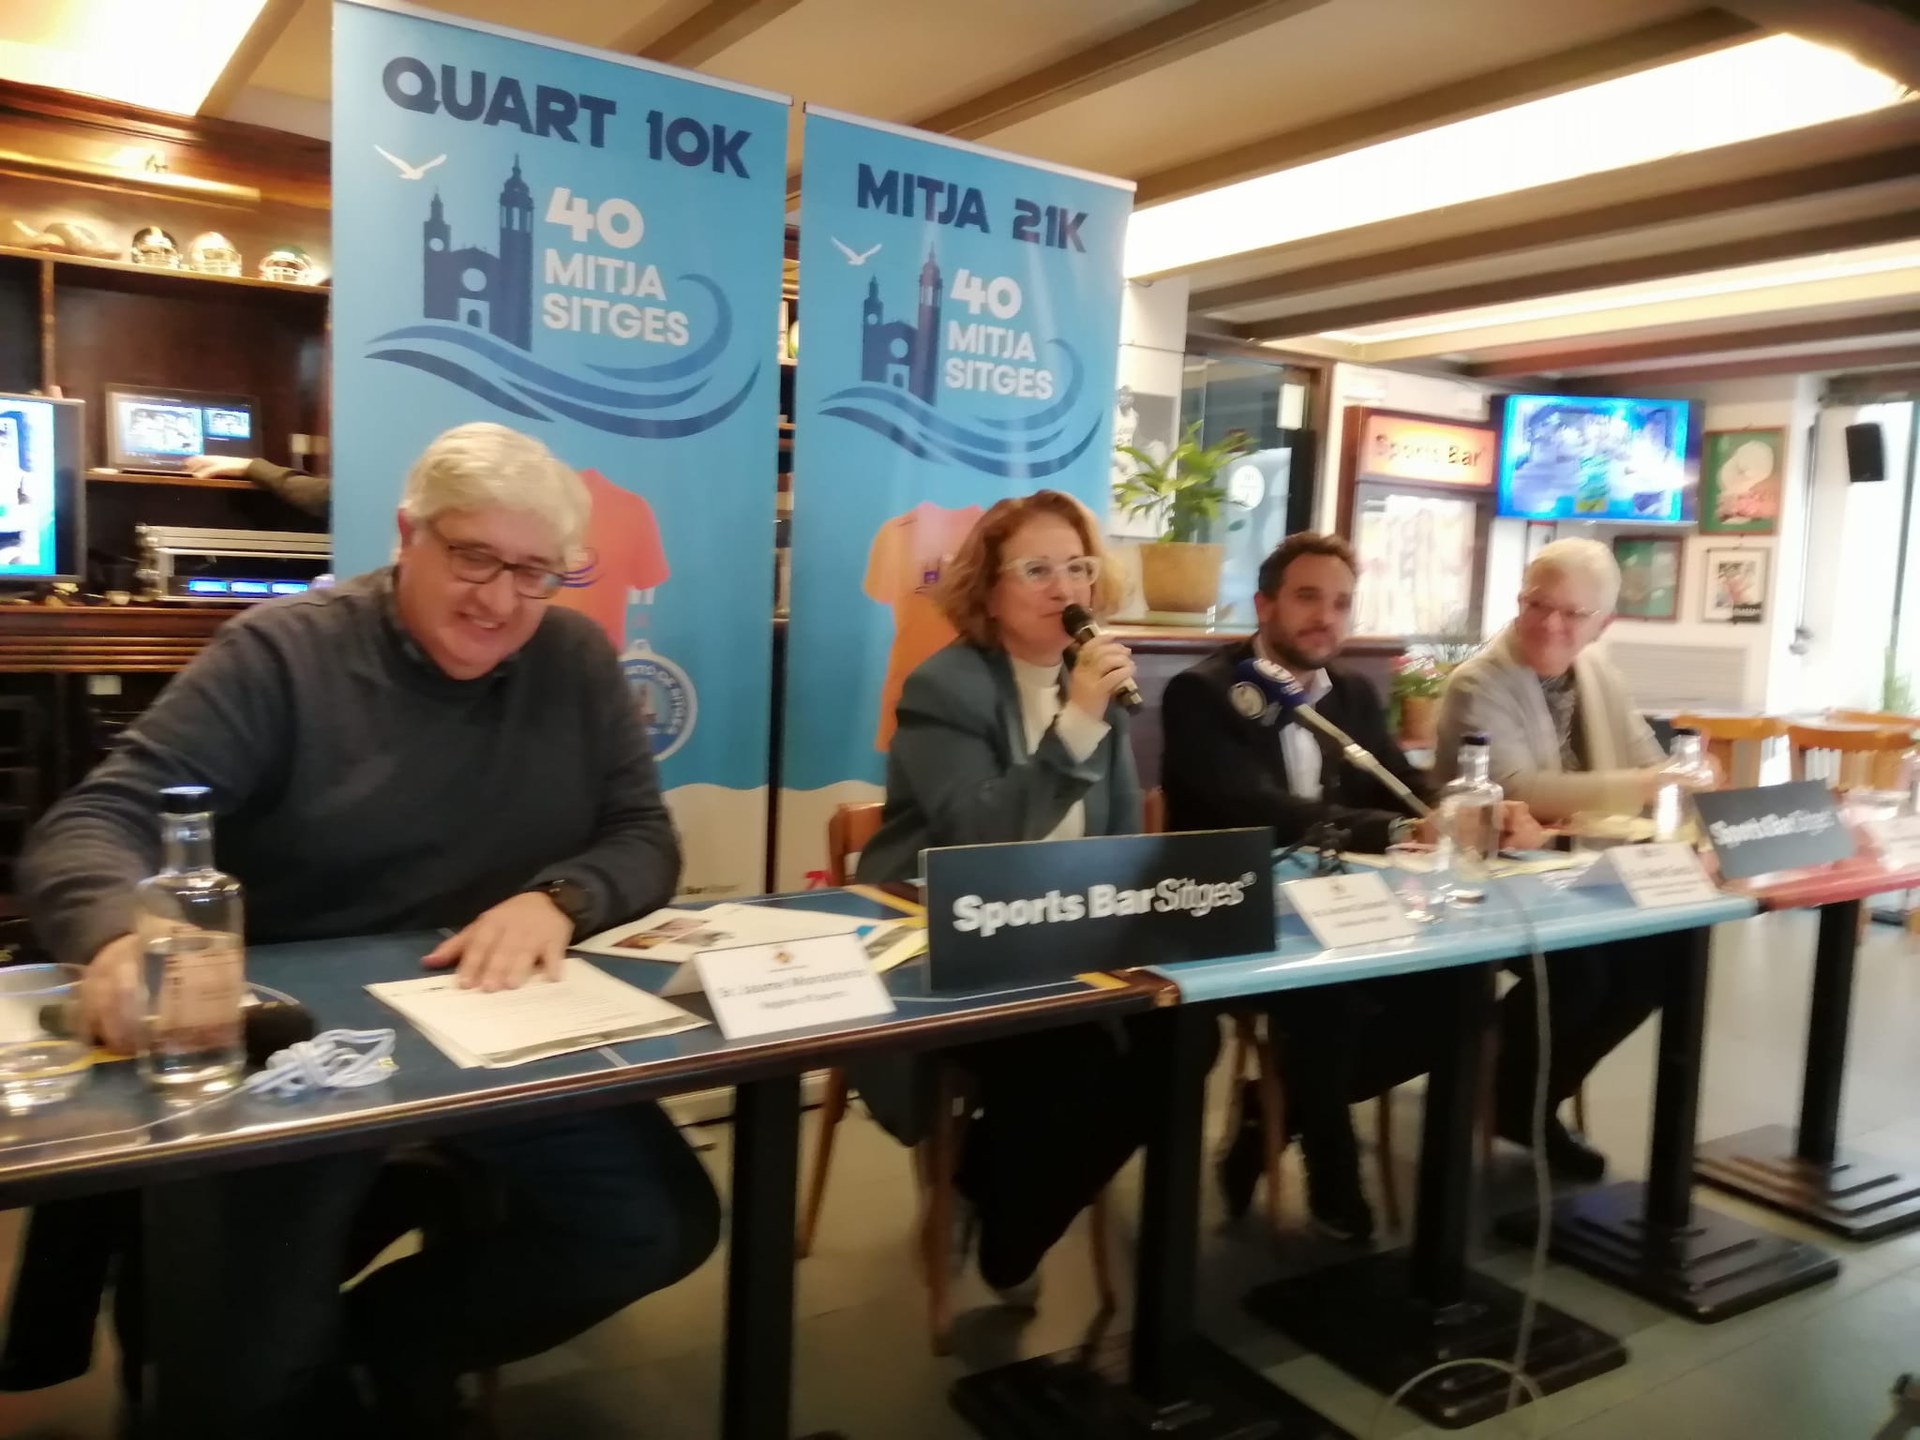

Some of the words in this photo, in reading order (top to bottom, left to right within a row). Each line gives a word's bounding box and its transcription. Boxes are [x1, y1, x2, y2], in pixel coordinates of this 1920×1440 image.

[382, 56, 617, 149] QUART
[645, 109, 753, 179] 10K
[544, 186, 645, 249] 40
[857, 163, 991, 234] MITJA
[1012, 198, 1089, 254] 21K
[544, 248, 668, 302] MITJA
[950, 268, 1022, 320] 40
[542, 293, 690, 347] SITGES
[947, 320, 1037, 363] MITJA
[945, 357, 1054, 401] SITGES
[1447, 444, 1481, 467] Bar
[952, 889, 1085, 938] Sports
[1088, 884, 1155, 919] Bar
